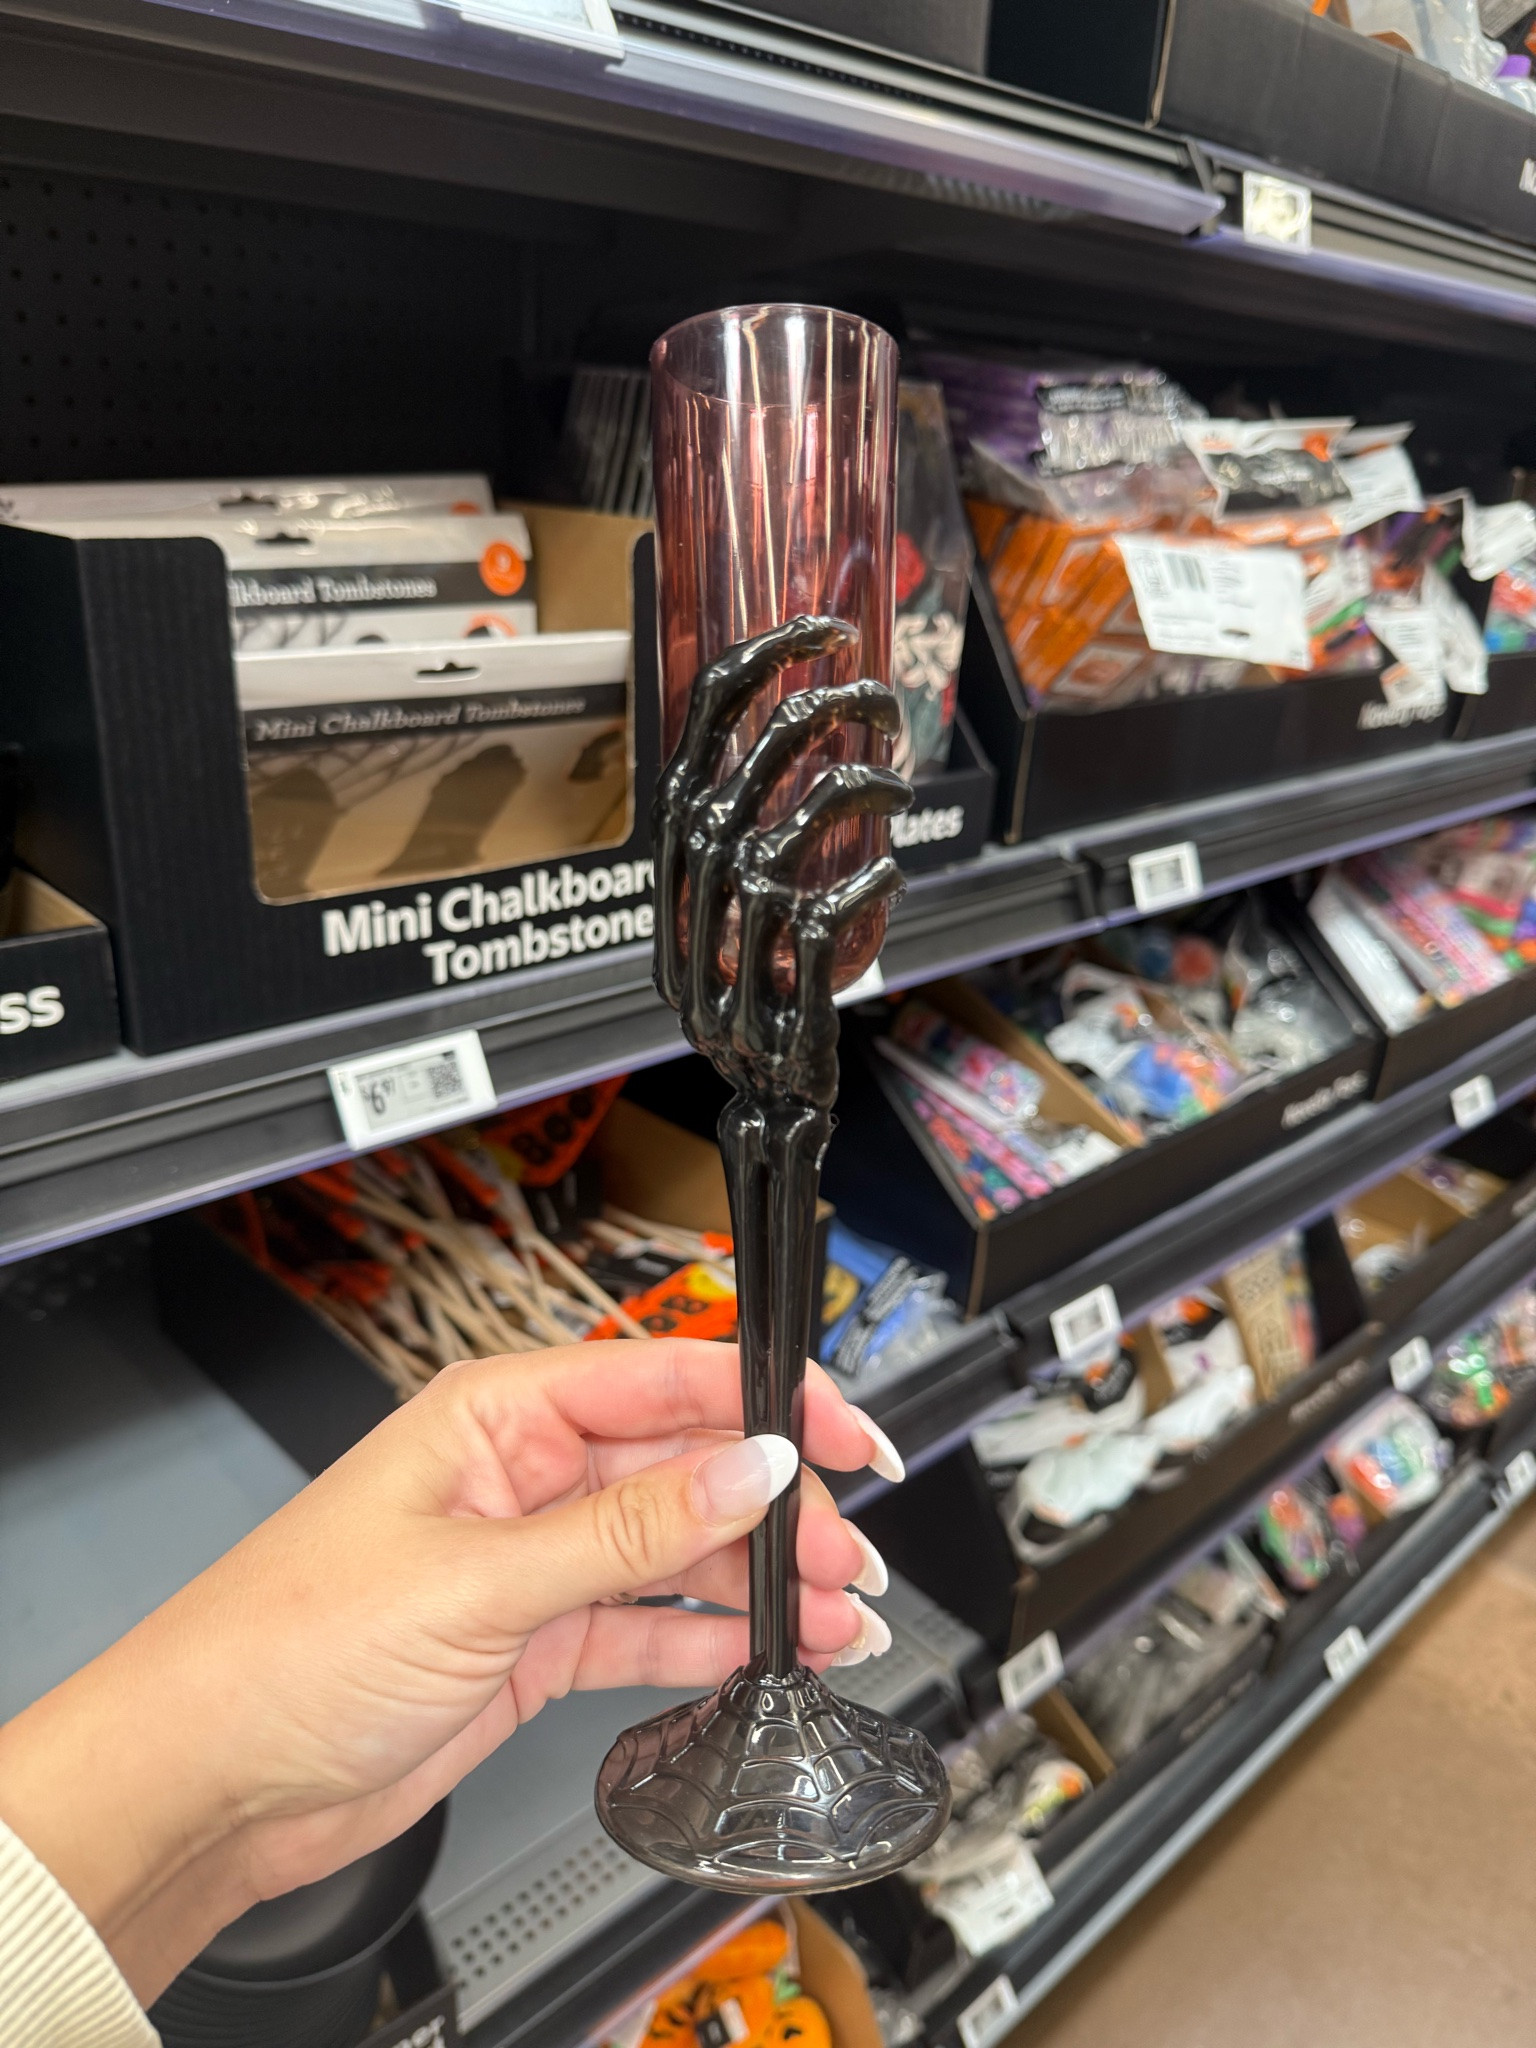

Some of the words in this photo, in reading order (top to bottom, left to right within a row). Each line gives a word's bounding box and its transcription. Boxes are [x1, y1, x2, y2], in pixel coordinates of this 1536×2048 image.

[316, 572, 437, 603] Tombstones
[253, 714, 317, 741] Mini
[320, 703, 463, 735] Chalkboard
[464, 697, 586, 723] Tombstones
[889, 804, 964, 849] lates
[322, 891, 433, 957] Mini
[437, 858, 656, 933] Chalkboar
[422, 903, 656, 985] Tombstone
